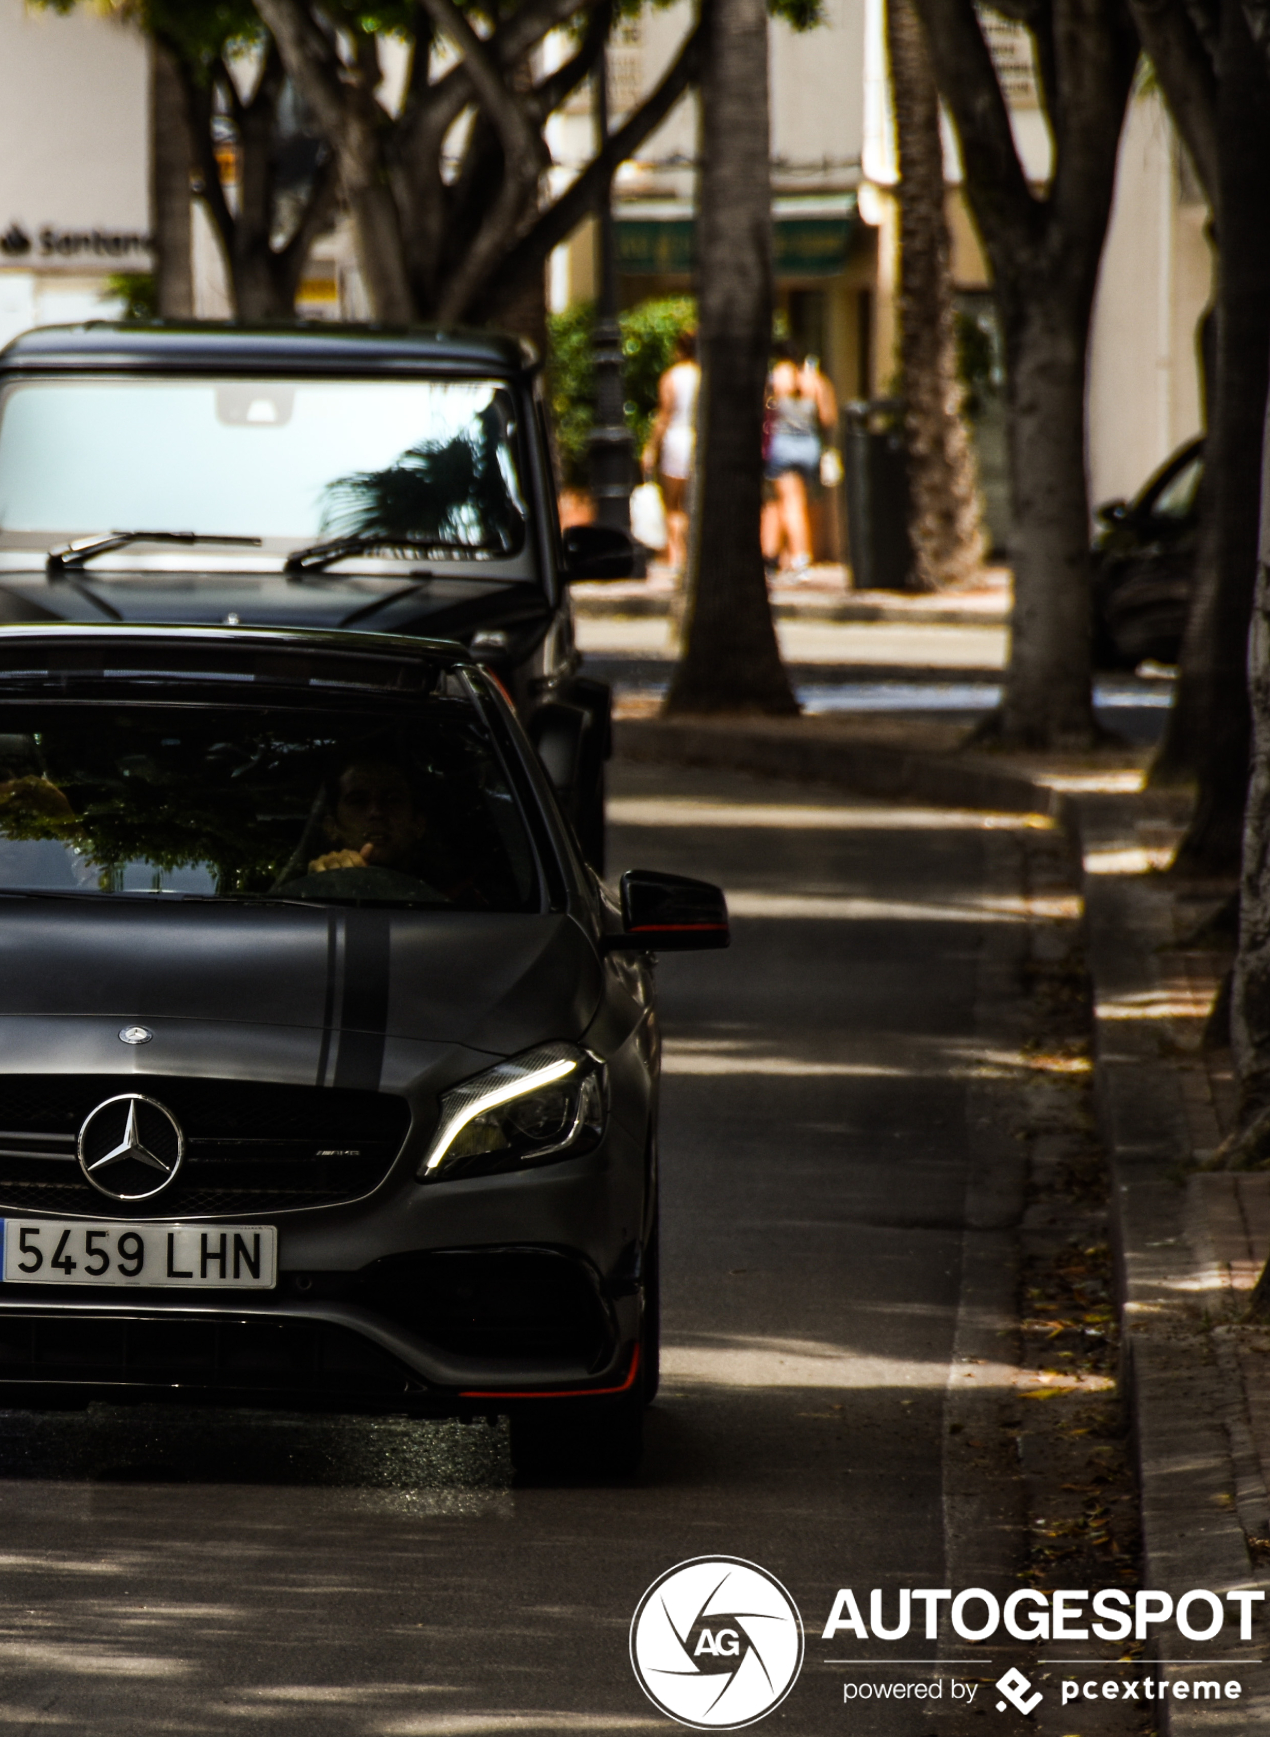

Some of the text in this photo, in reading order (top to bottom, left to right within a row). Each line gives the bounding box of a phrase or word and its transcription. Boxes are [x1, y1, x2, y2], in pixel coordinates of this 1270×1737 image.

[39, 227, 151, 257] Santan
[17, 1227, 262, 1280] 5459 LHN
